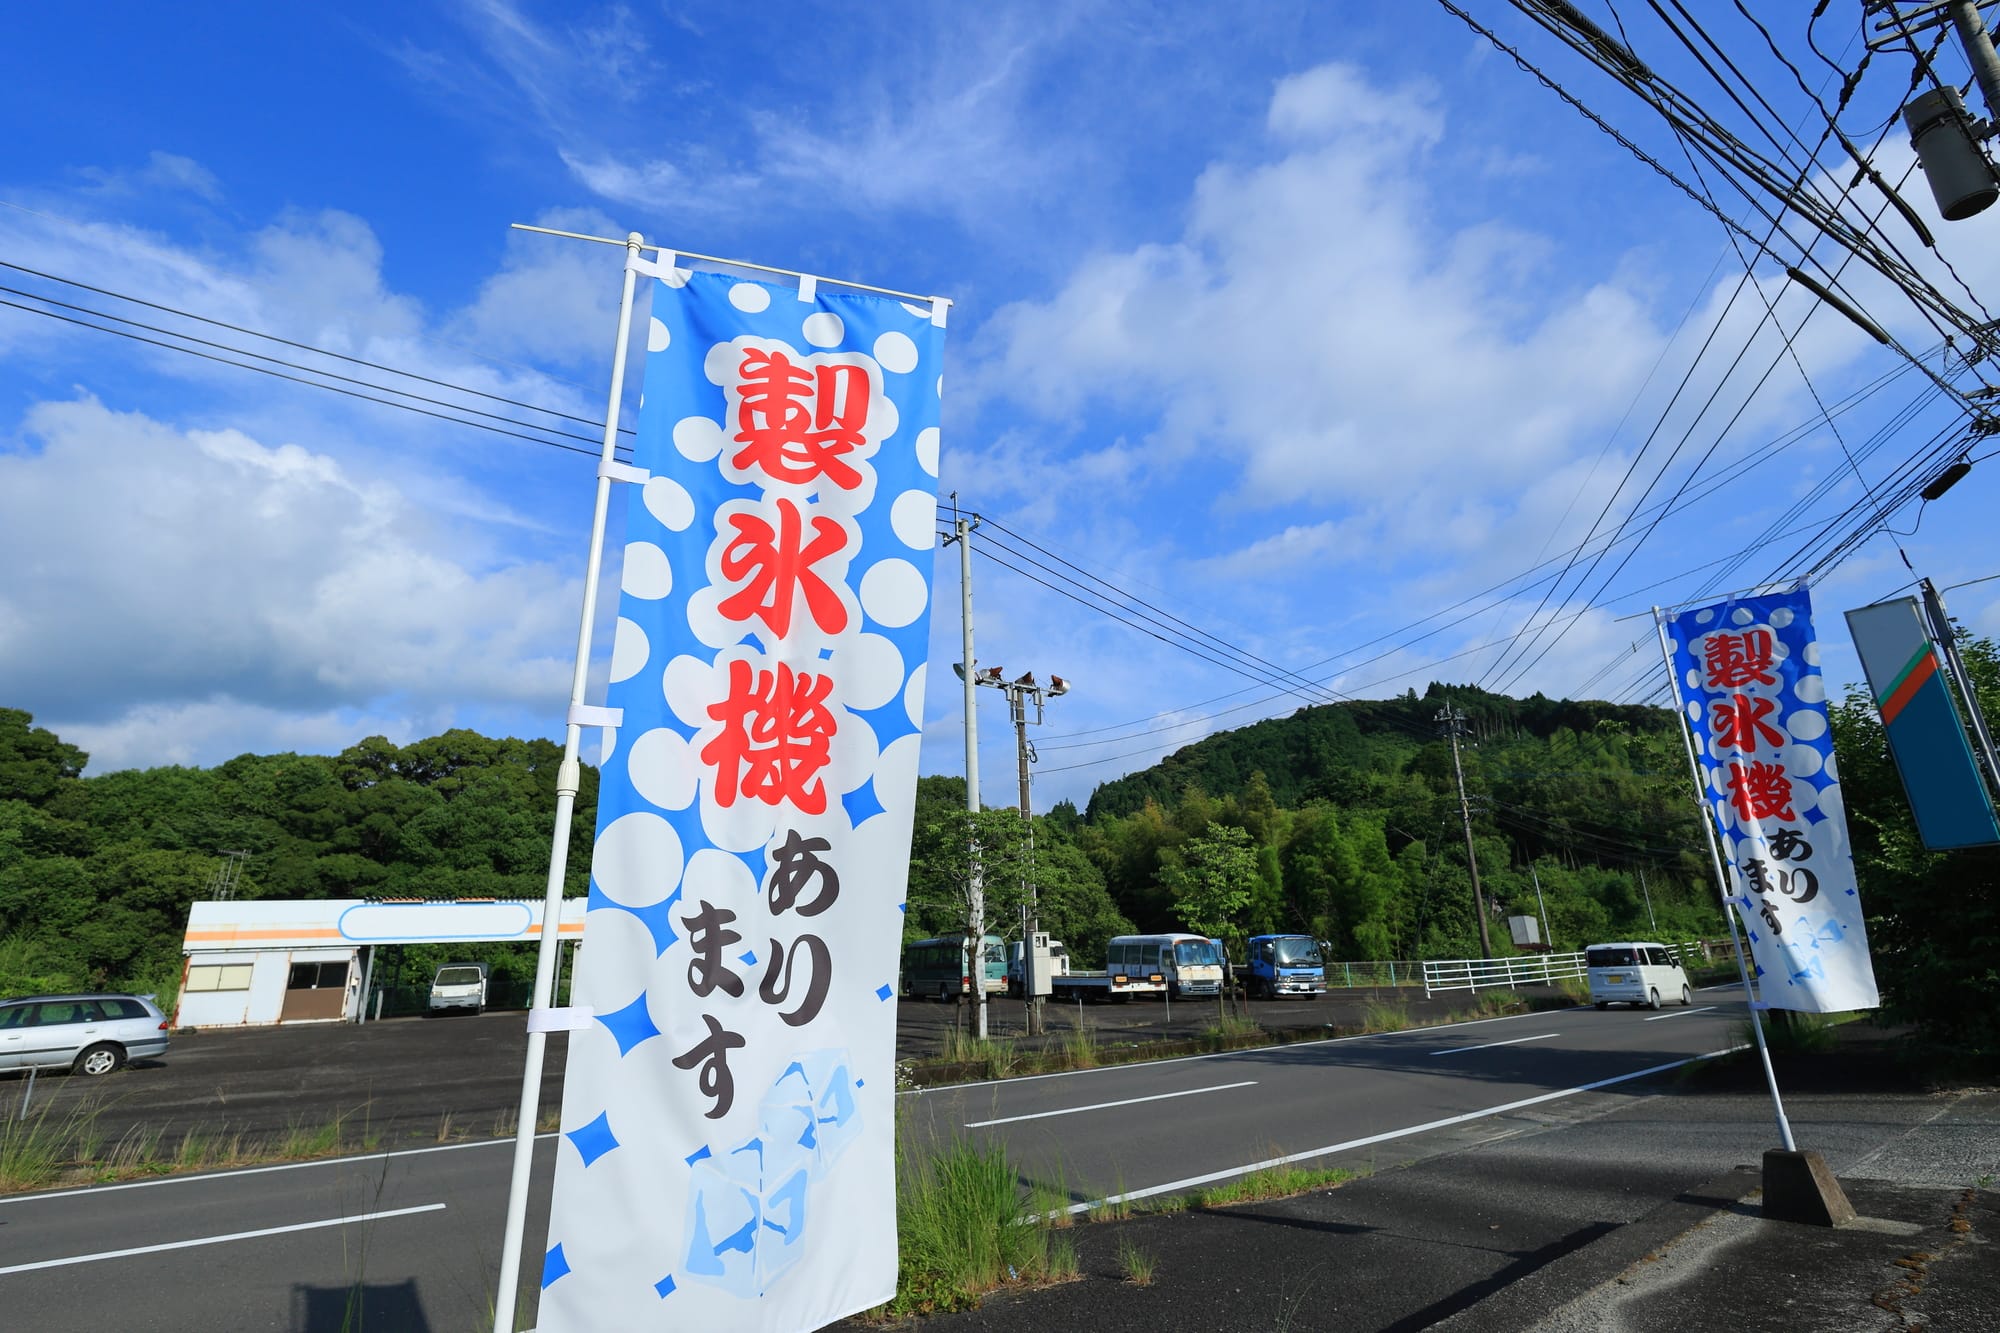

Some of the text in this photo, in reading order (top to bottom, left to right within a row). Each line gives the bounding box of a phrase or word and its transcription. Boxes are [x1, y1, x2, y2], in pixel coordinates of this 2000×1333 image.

[701, 347, 871, 816] 製氷機
[1704, 629, 1796, 822] 製氷機
[757, 829, 840, 1028] あり
[1742, 857, 1782, 935] ます
[1766, 827, 1819, 904] あり
[672, 900, 746, 1119] ます
